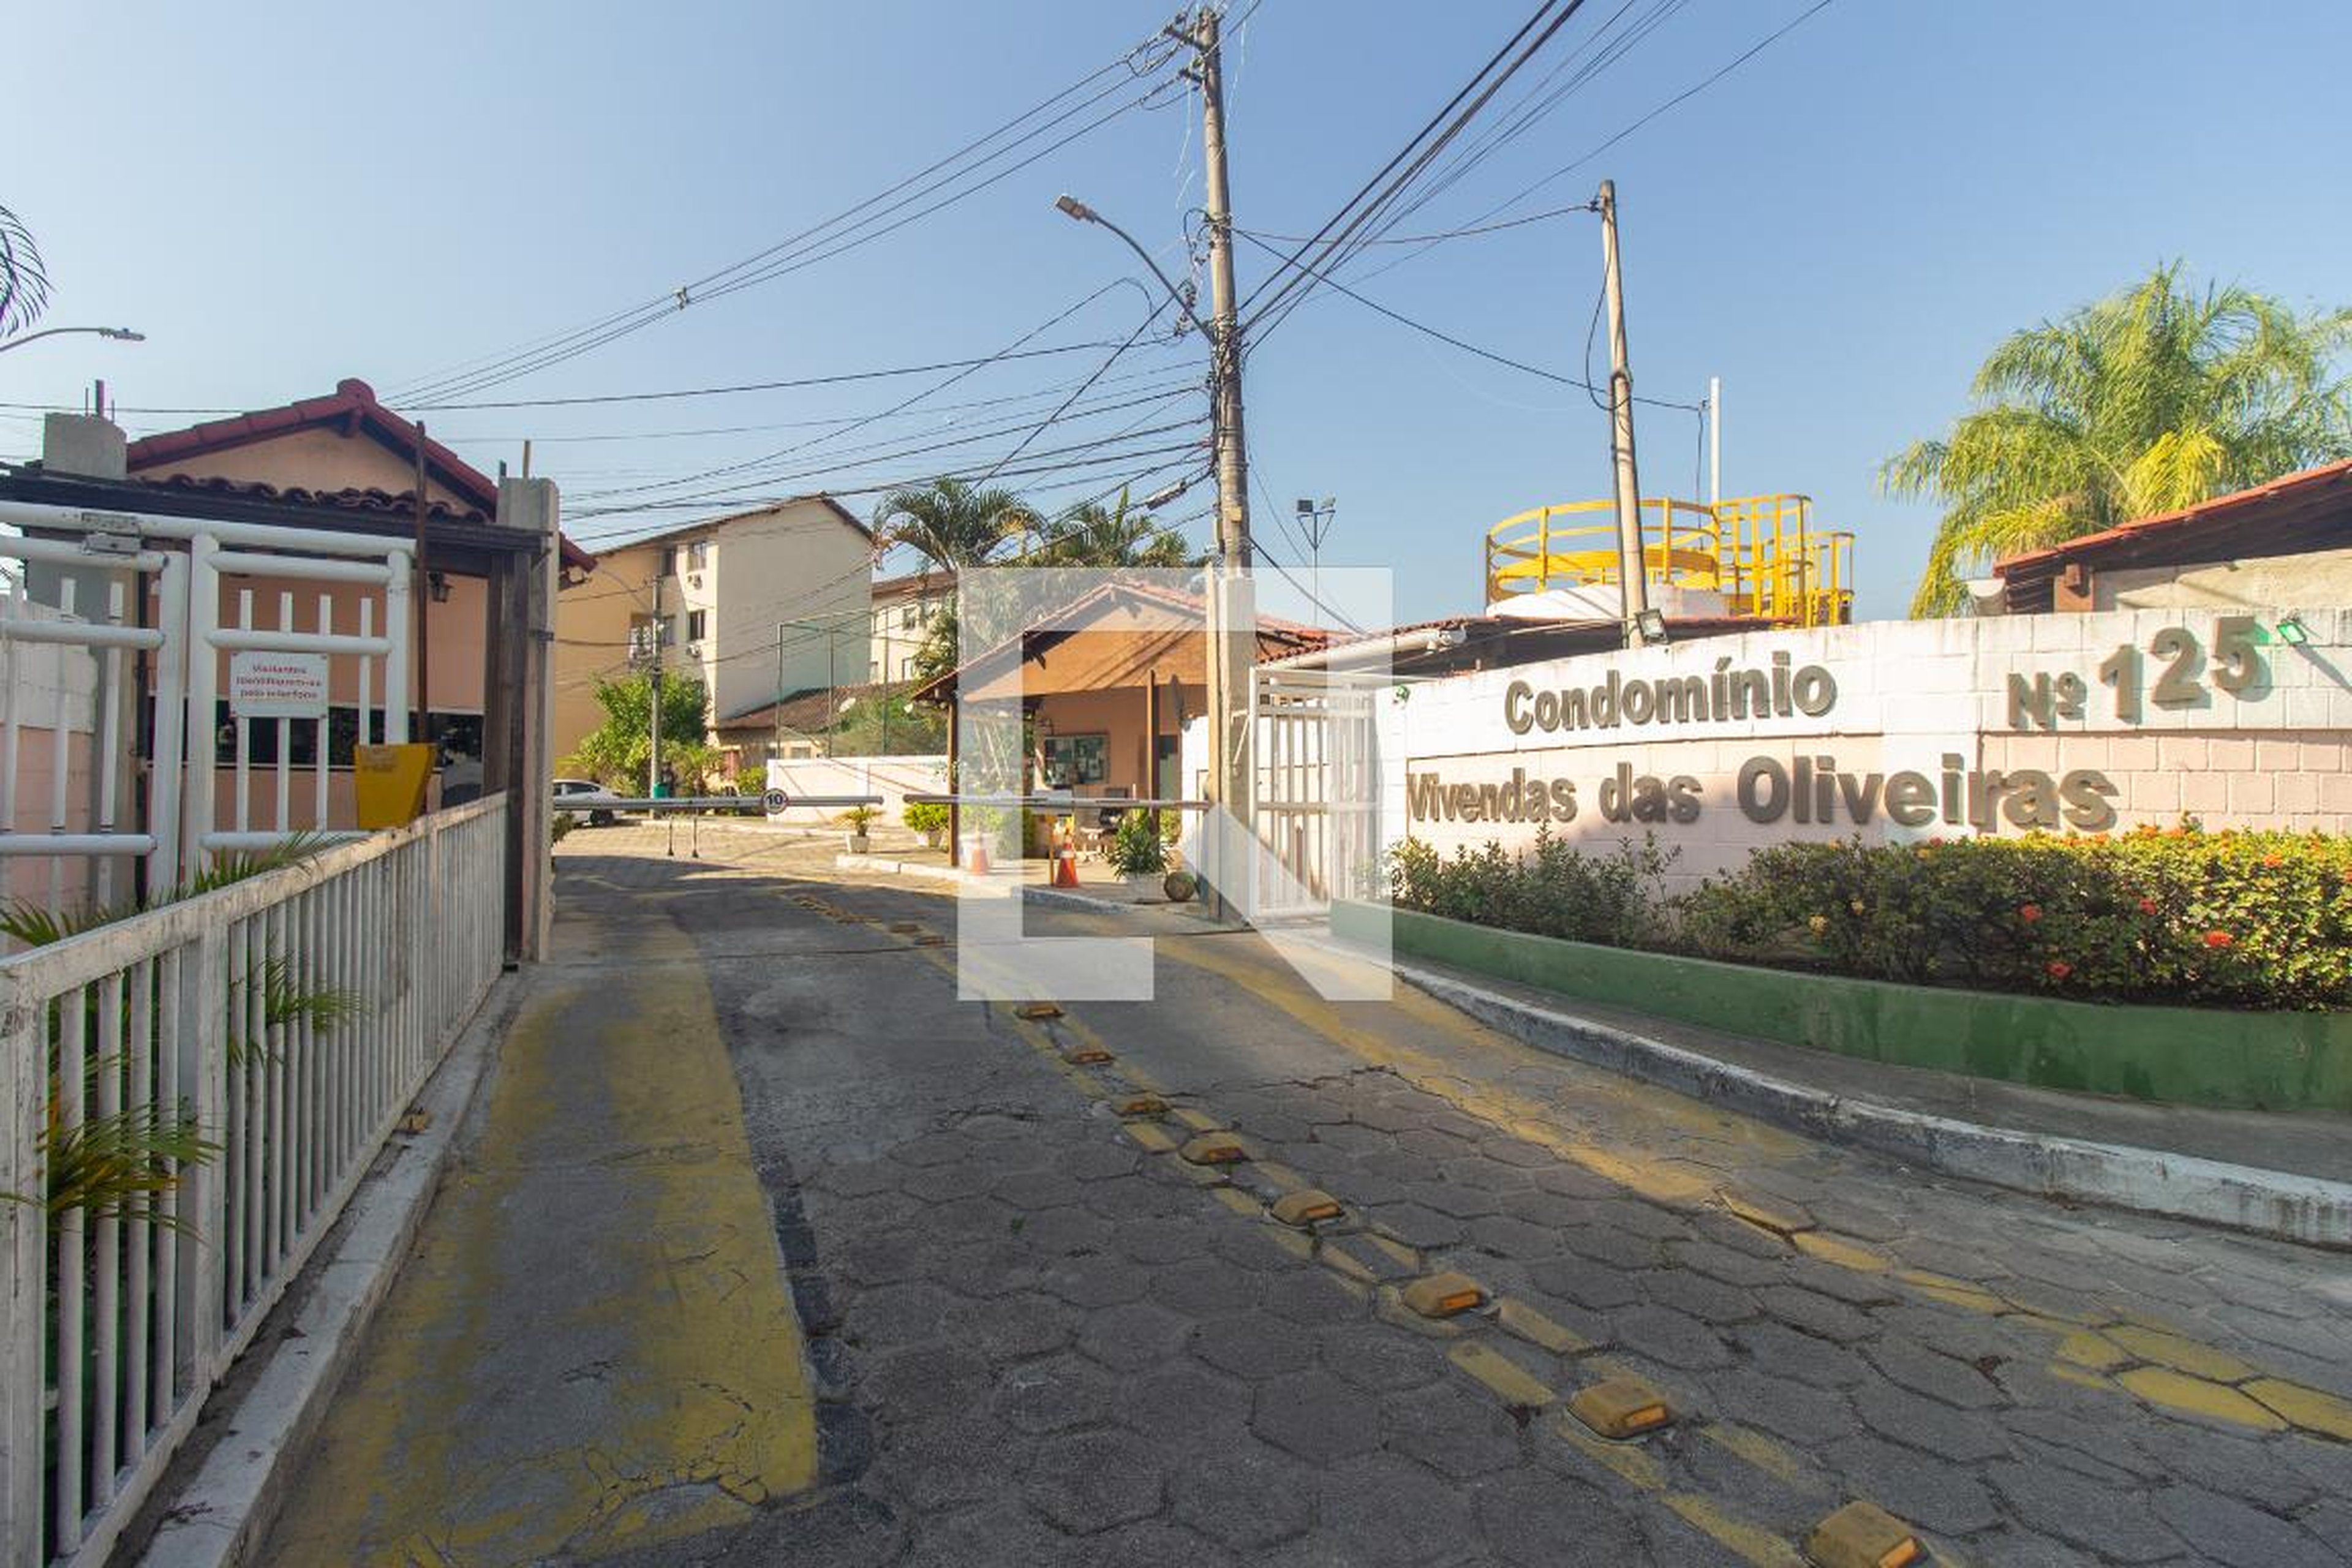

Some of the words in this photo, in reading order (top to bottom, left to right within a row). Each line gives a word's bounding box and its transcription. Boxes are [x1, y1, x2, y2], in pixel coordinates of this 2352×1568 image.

[1504, 650, 1838, 734] Condomínio
[2099, 616, 2271, 724] 125
[766, 793, 783, 805] 10
[1406, 766, 1579, 823] Vivendas
[1597, 761, 1703, 824] das
[1736, 753, 2119, 832] Oliveiras
